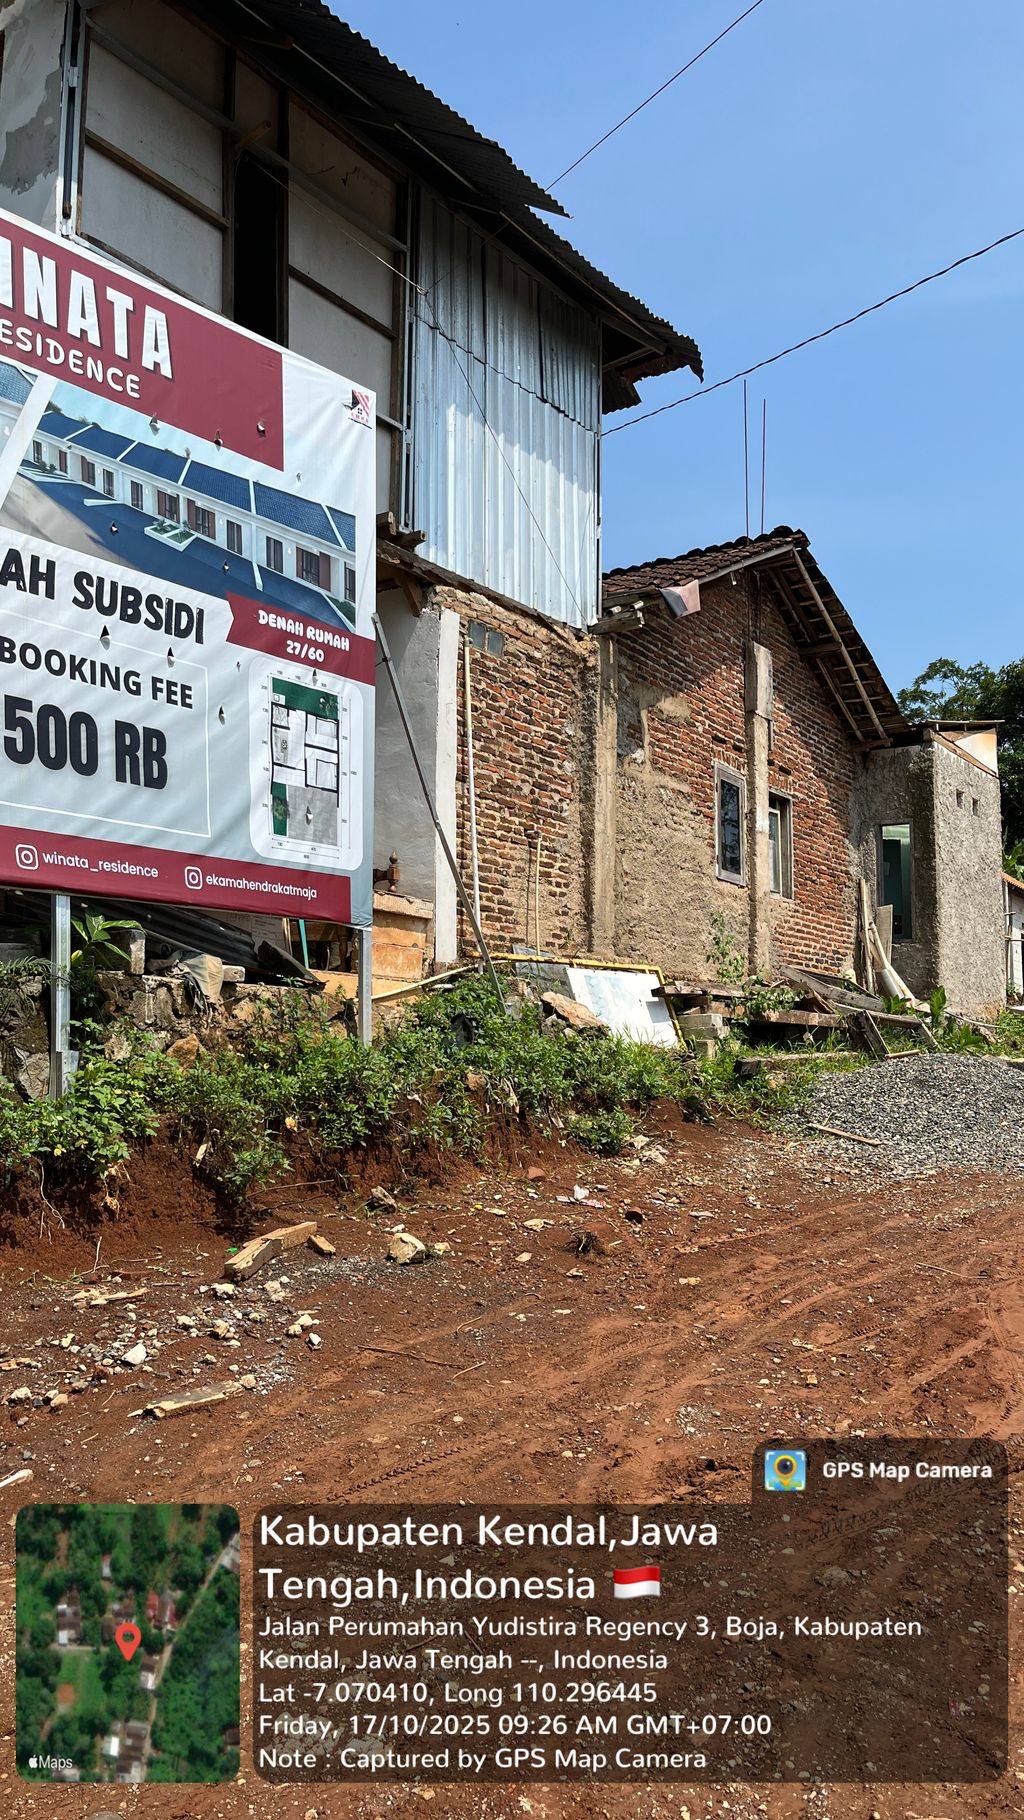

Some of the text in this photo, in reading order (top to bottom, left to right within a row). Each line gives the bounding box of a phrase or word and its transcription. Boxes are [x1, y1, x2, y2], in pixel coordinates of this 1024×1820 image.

[0, 548, 205, 645] AH SUBSIDI
[258, 609, 350, 652] DENAH RUMAH
[286, 640, 325, 663] 27/60
[0, 635, 193, 710] BOOKING FEE
[3, 694, 168, 790] 500 RB
[42, 851, 159, 878] winata_residence
[206, 874, 317, 900] ekamahendrakatmaja
